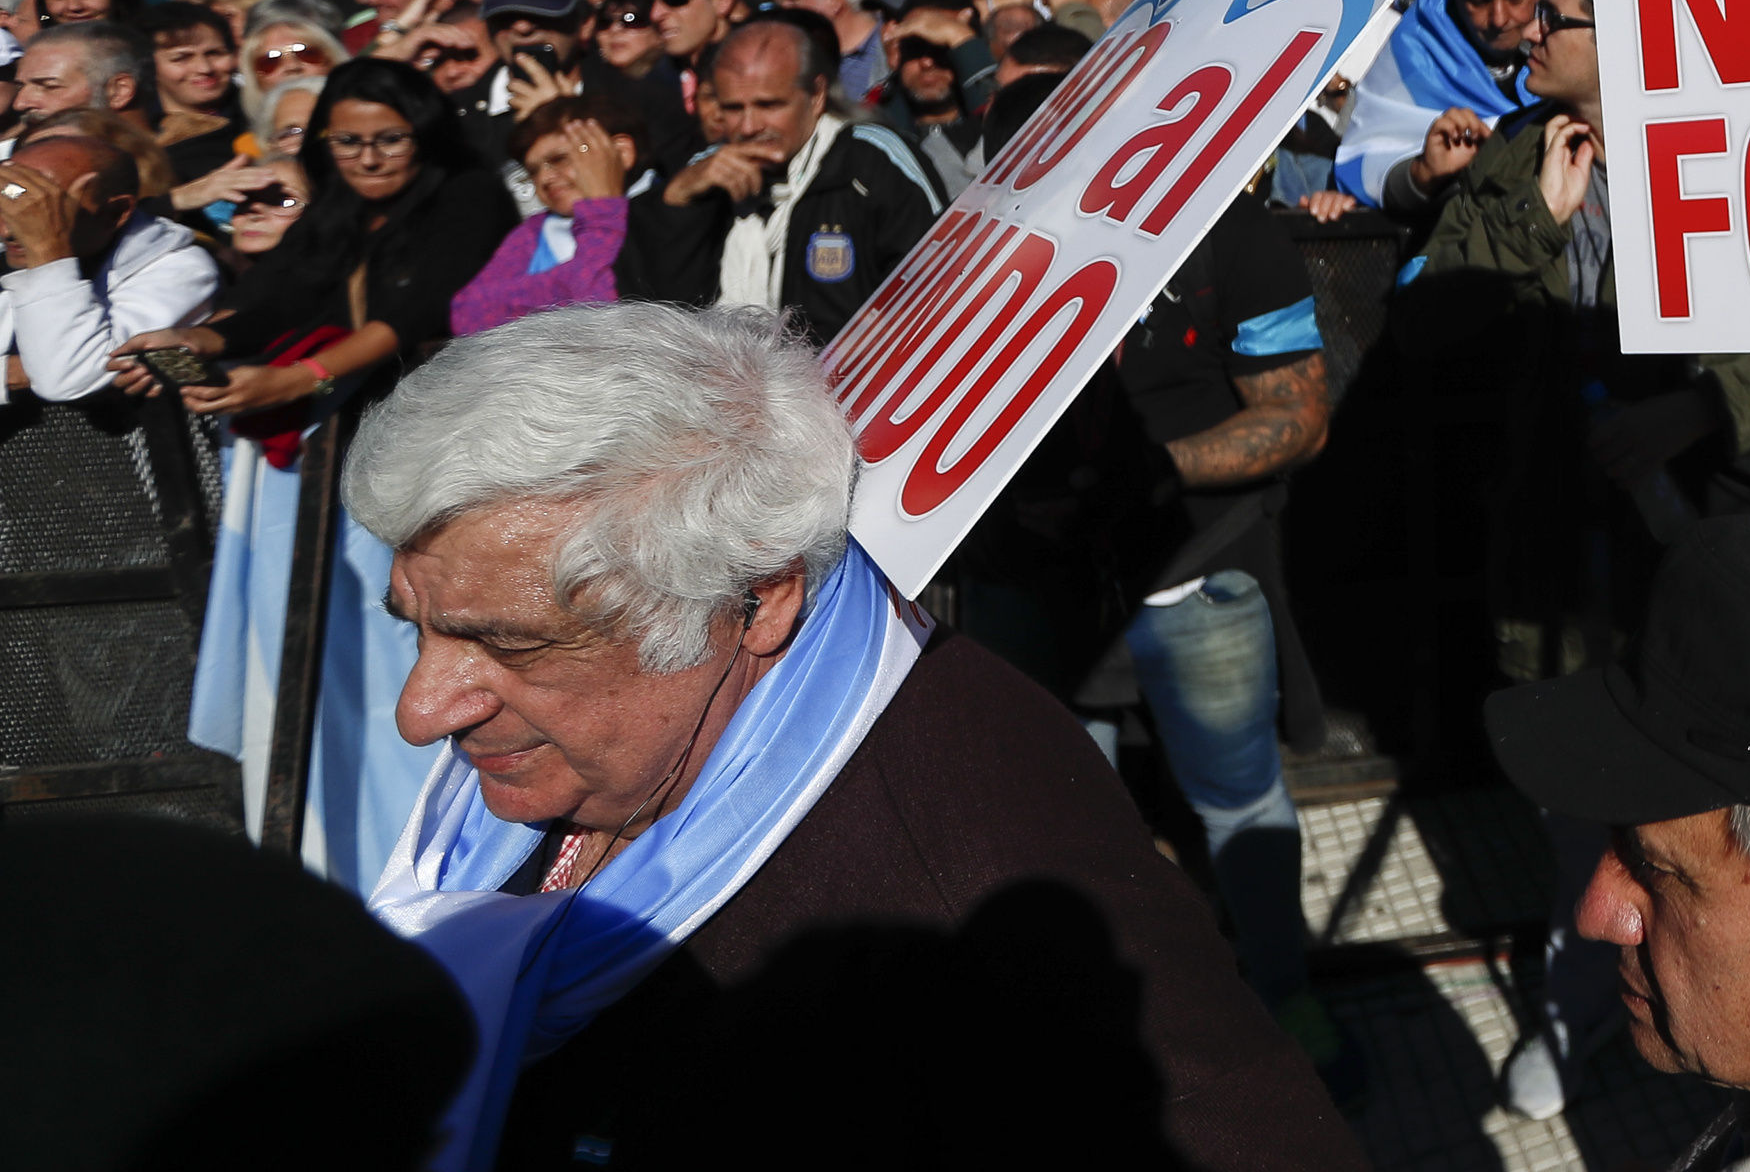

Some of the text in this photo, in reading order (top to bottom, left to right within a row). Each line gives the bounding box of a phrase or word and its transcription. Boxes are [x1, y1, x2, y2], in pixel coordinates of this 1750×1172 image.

[982, 20, 1324, 236] NO al
[822, 211, 1118, 516] FONDO
